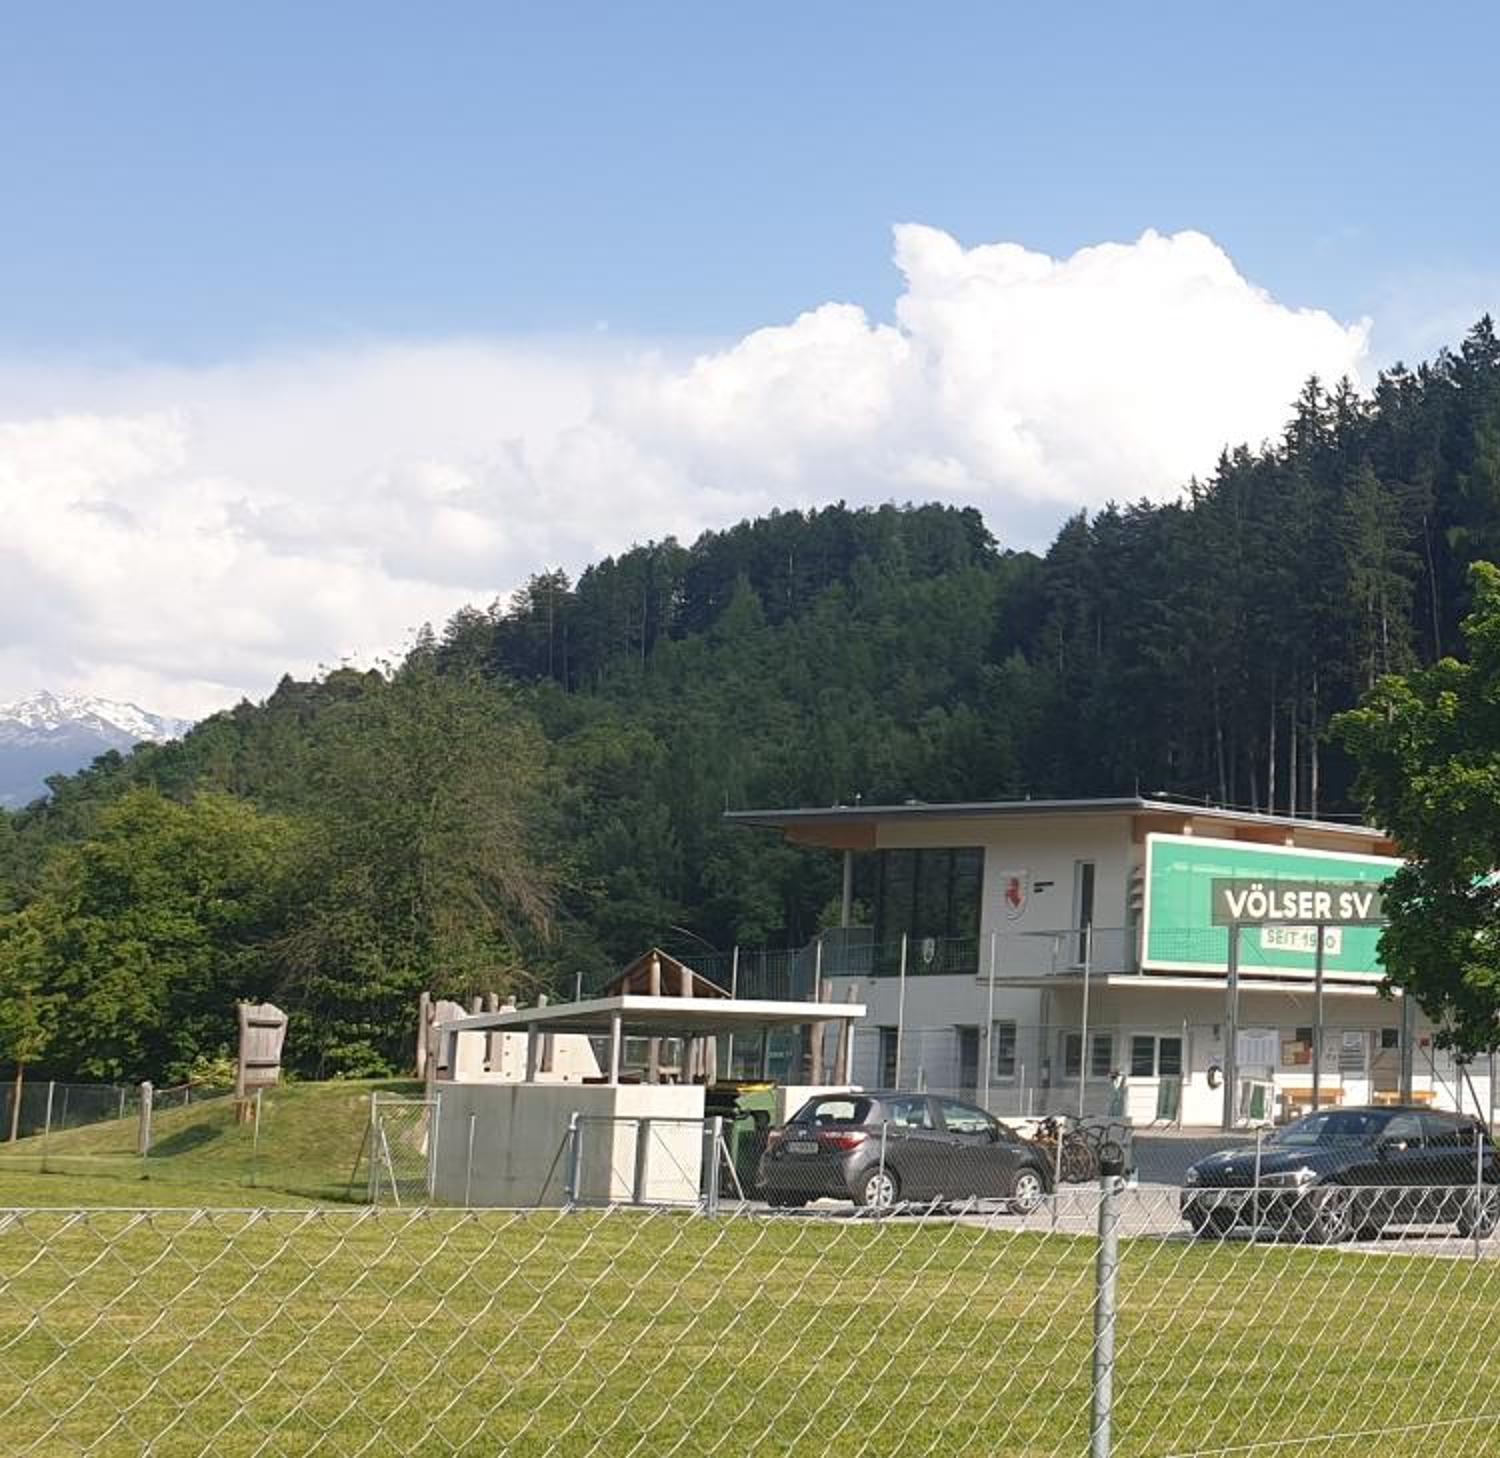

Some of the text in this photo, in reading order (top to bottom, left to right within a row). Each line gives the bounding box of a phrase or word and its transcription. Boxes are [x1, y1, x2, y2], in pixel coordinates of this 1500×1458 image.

[1224, 883, 1373, 919] VÖLSER SV
[1267, 928, 1336, 949] SEIT 190
